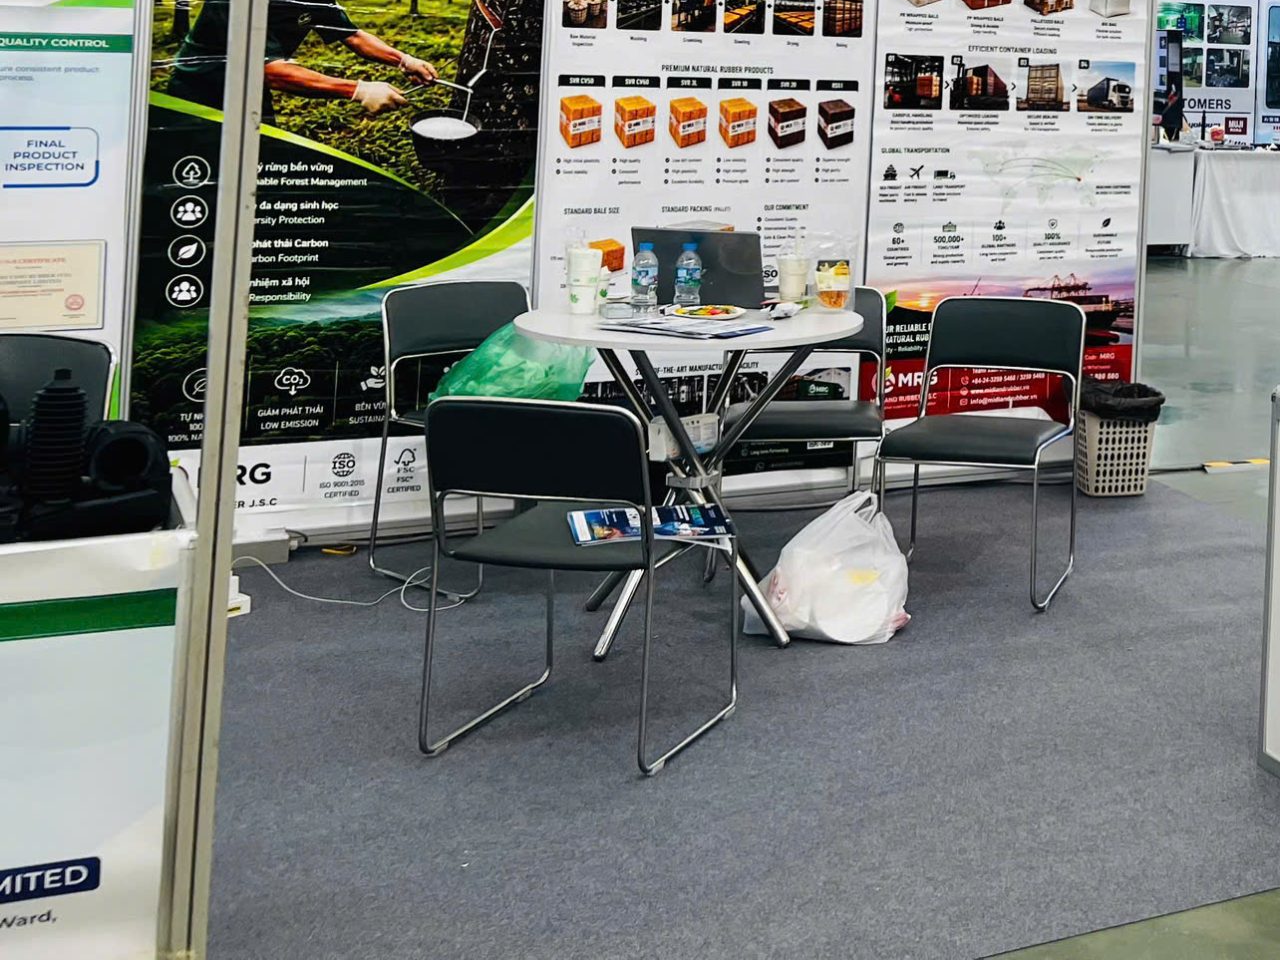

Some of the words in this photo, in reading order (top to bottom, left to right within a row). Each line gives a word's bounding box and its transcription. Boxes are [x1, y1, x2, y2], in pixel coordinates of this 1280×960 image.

[51, 38, 109, 49] CONTROL
[661, 64, 690, 73] PREMIUM
[691, 65, 718, 73] NATURAL
[719, 66, 742, 74] RUBBER
[743, 66, 774, 75] PRODUCTS
[26, 139, 65, 148] FINAL
[13, 151, 79, 160] PRODUCT
[5, 162, 85, 172] INSPECTION
[280, 177, 309, 186] Forest
[310, 177, 368, 188] Management
[299, 200, 320, 210] sinh
[764, 203, 774, 212] OUR
[774, 204, 810, 212] COMMITMENT
[564, 207, 592, 215] STANDARD
[594, 207, 607, 215] BALE
[608, 206, 620, 215] SIZE
[278, 215, 325, 226] Protection
[294, 238, 329, 248] Carbon
[278, 253, 319, 264] Footprint
[249, 292, 311, 302] Responsibility
[257, 407, 279, 417] GIẢM
[280, 405, 303, 416] PHÁT
[305, 404, 324, 414] THẢI
[260, 421, 279, 430] LOW
[280, 419, 319, 429] EMISSION
[331, 460, 356, 469] ISO
[387, 484, 421, 494] CERTIFIED
[324, 490, 360, 499] CERTIFIED
